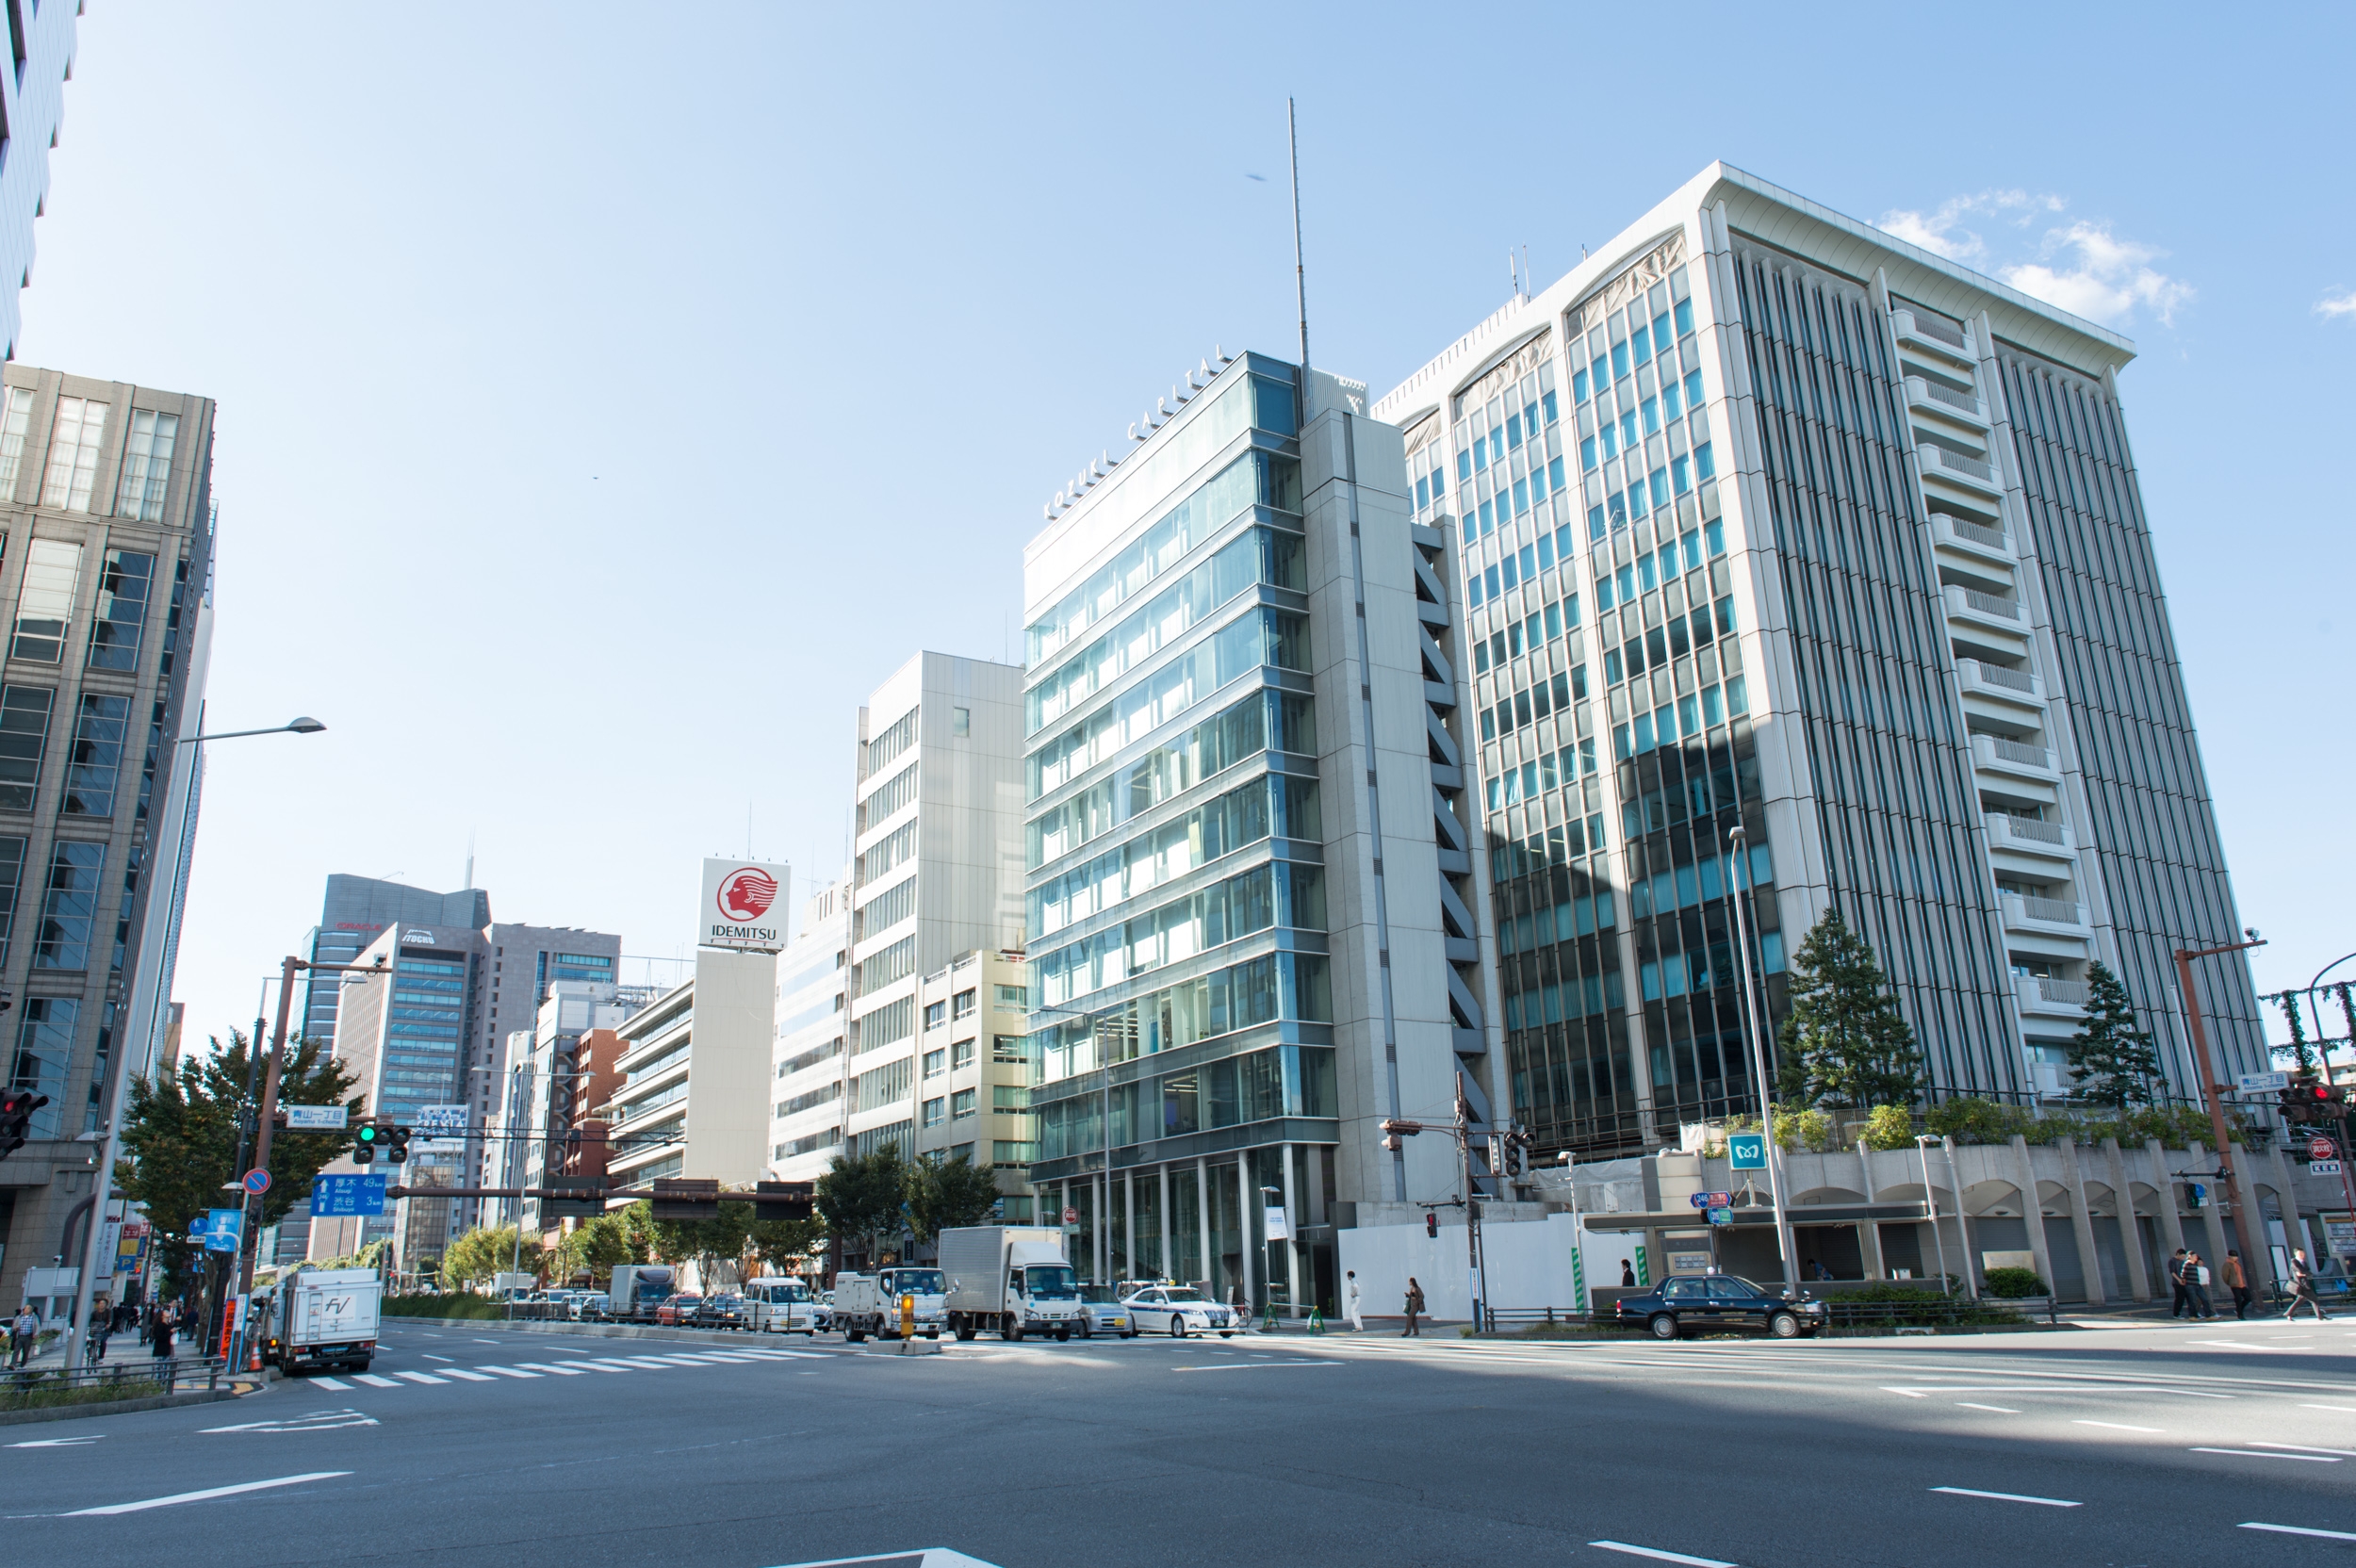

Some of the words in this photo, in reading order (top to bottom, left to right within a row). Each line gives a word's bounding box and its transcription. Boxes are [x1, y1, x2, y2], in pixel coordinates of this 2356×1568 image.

[335, 922, 382, 932] ORACLE
[712, 924, 777, 940] IDEMITSU
[401, 934, 435, 945] ITOCHU
[2241, 1074, 2284, 1086] 青山一丁目
[293, 1109, 343, 1119] 青山一丁目
[2312, 1144, 2331, 1153] 消火栓
[335, 1178, 356, 1188] 厚木
[334, 1197, 355, 1206] 渋谷
[1696, 1193, 1709, 1202] 246
[122, 1259, 131, 1267] P
